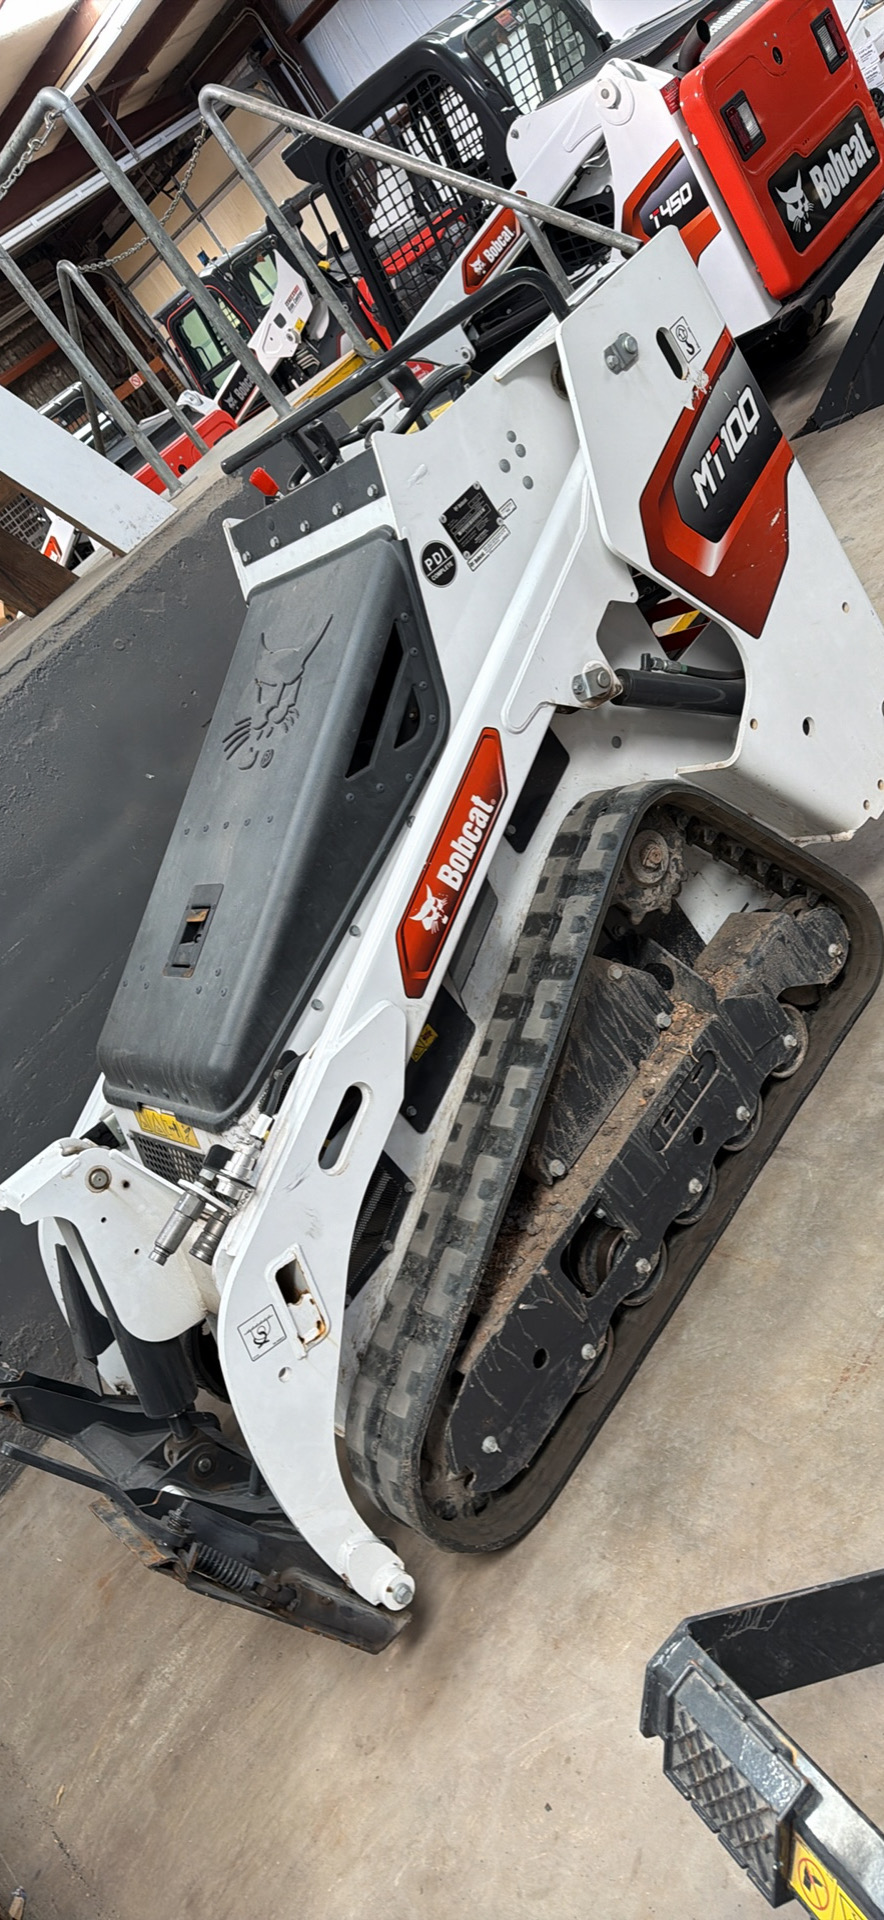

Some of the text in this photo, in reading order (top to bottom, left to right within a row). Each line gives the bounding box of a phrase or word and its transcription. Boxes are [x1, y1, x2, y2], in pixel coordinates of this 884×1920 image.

[809, 122, 872, 209] Bobcat
[649, 182, 692, 229] T450
[482, 225, 515, 263] Bobcat
[691, 385, 760, 509] MT100
[424, 547, 448, 571] PDI
[430, 560, 454, 581] COMPLETE
[437, 795, 494, 891] Bobcat
